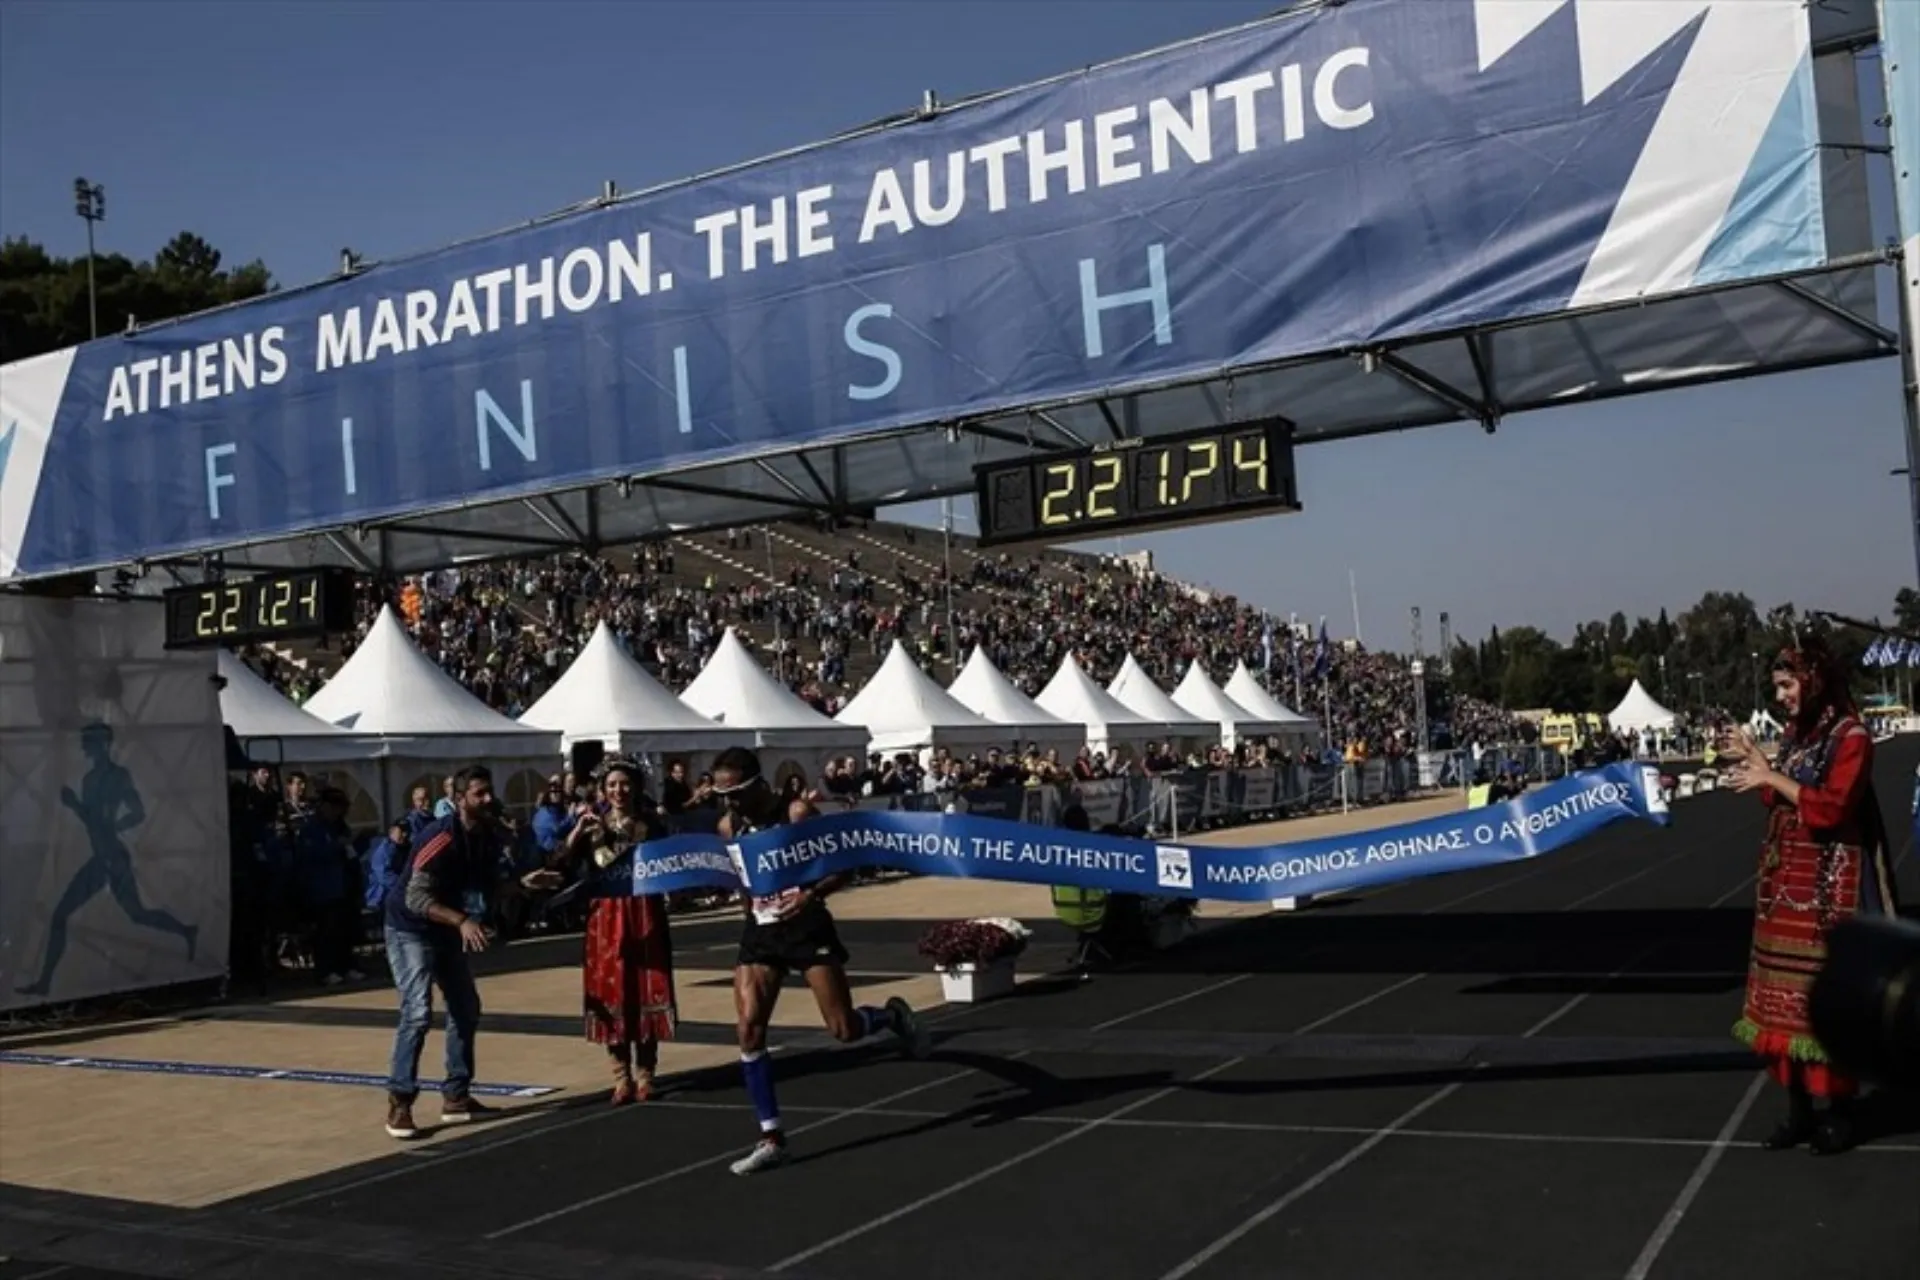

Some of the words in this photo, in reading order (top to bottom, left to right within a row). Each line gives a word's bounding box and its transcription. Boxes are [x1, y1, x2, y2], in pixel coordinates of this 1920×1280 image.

[103, 326, 287, 421] ATHENS
[317, 231, 674, 372] MARATHON.
[694, 184, 834, 280] THE
[858, 45, 1376, 243] AUTHENTIC
[204, 243, 1176, 520] FINISH
[755, 831, 840, 876] ATHENS
[841, 829, 966, 859] MARATHON.
[971, 836, 1016, 863] THE
[1019, 841, 1147, 875] AUTHENTIC
[1206, 847, 1360, 886] ΜΑΡΑΘΩΝΙΟΣ
[1365, 827, 1472, 866] ΑΘΗΝΑΣ.
[1474, 822, 1495, 844] Ο
[1499, 781, 1634, 841] ΑΥΘΕΝΤΙΚΟΣ
